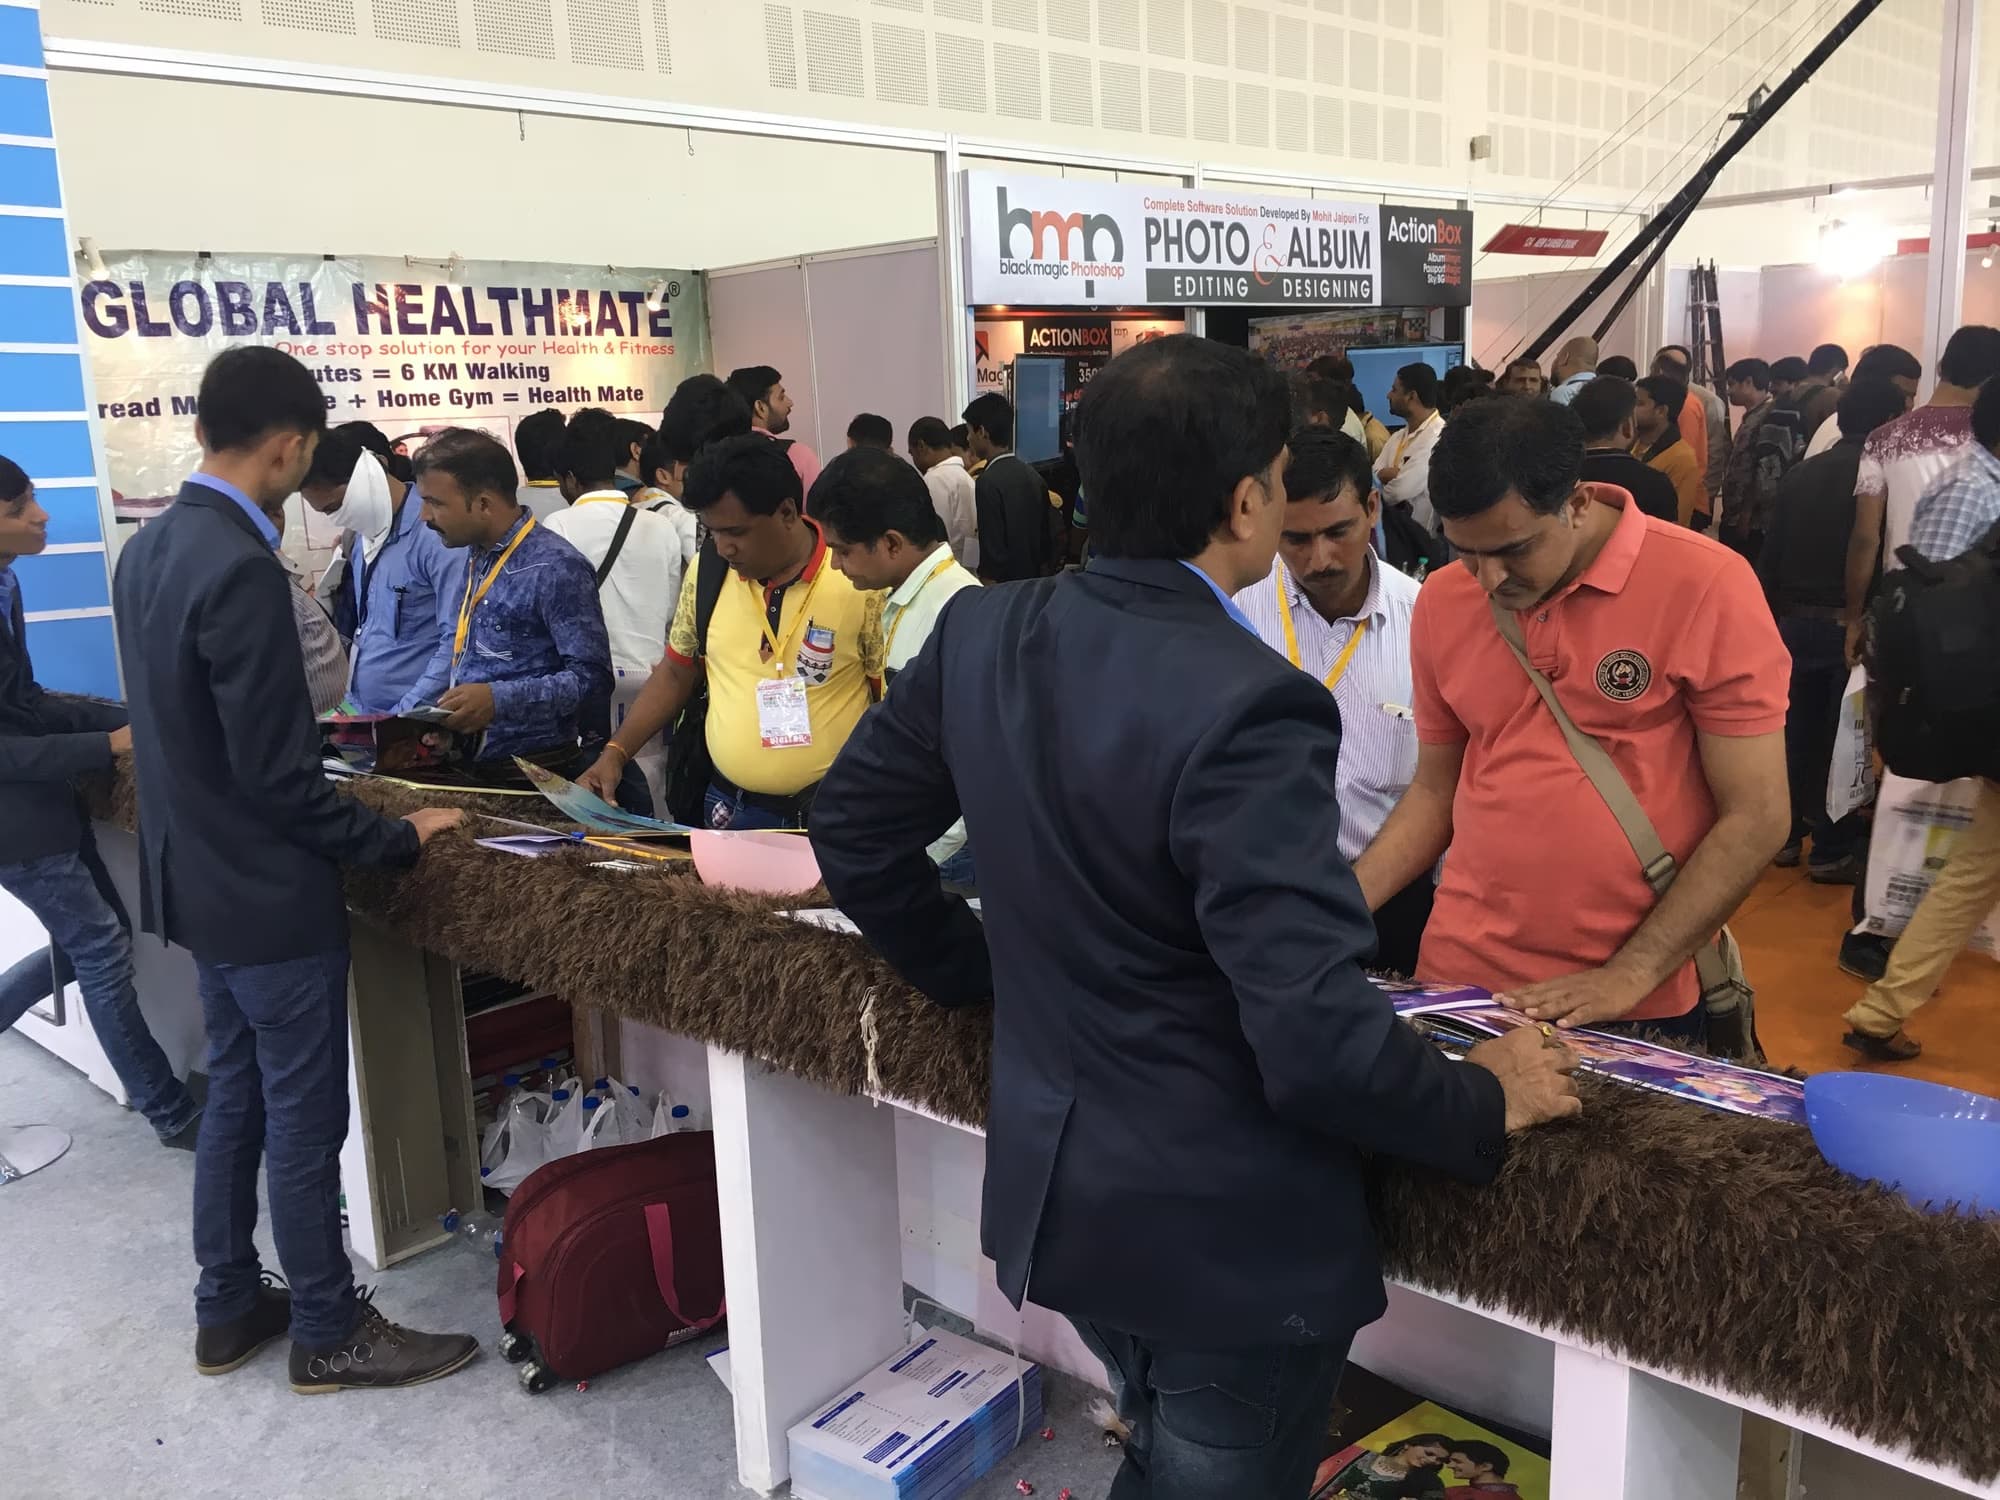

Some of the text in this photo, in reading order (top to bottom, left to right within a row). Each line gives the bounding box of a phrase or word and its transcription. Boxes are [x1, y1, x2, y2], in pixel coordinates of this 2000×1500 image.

[1144, 197, 1370, 225] Complete Software Solution Developed By Mohit Jaipuri For
[997, 186, 1124, 298] bmp
[1388, 216, 1462, 245] ActionBox
[1145, 217, 1250, 266] PHOTO
[1287, 226, 1371, 269] ALBUM
[1071, 261, 1125, 281] Photoshop
[1174, 276, 1371, 298] EDITING DESIGNING
[81, 280, 336, 339] GLOBAL
[275, 340, 675, 359] One stop solution for your Health & Fitness
[1029, 328, 1109, 348] ACTIONBOX
[312, 366, 362, 383] utes
[401, 364, 415, 381] 6
[424, 363, 459, 381] KM
[465, 362, 551, 382] Walking
[98, 397, 161, 419] read
[377, 389, 441, 408] Home
[449, 388, 494, 410] Gym
[528, 385, 592, 404] Health
[599, 384, 644, 402] Mate
